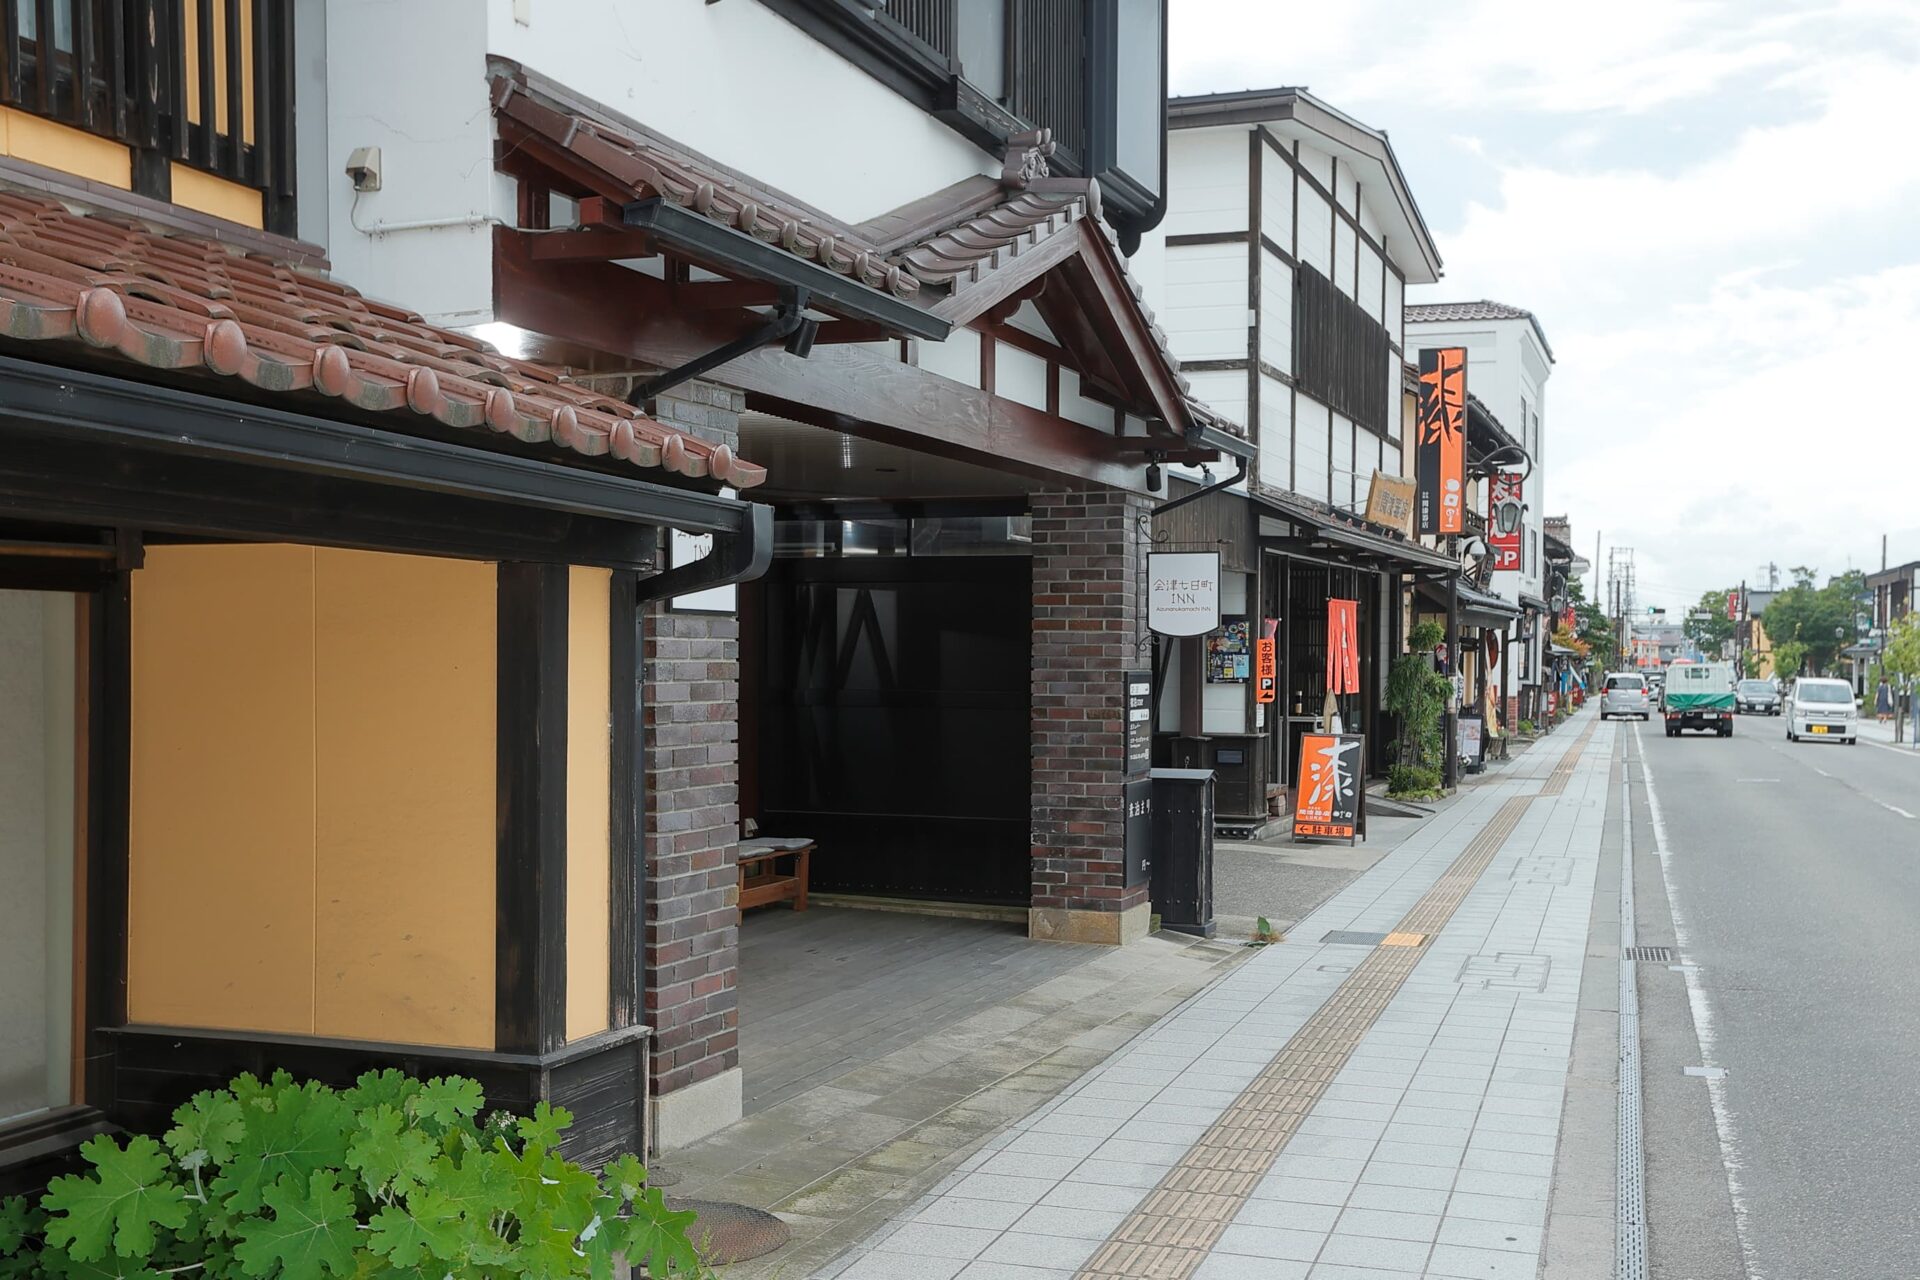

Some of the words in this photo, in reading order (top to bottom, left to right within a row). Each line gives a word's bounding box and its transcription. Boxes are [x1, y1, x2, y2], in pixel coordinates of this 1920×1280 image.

[1420, 351, 1463, 448] 漆
[1504, 551, 1518, 566] P
[1153, 578, 1214, 592] 会津七日町
[1171, 593, 1196, 604] INN
[1261, 642, 1273, 676] お客様
[1262, 678, 1272, 690] P
[1308, 737, 1361, 808] 漆
[1312, 825, 1345, 837] 駐車場
